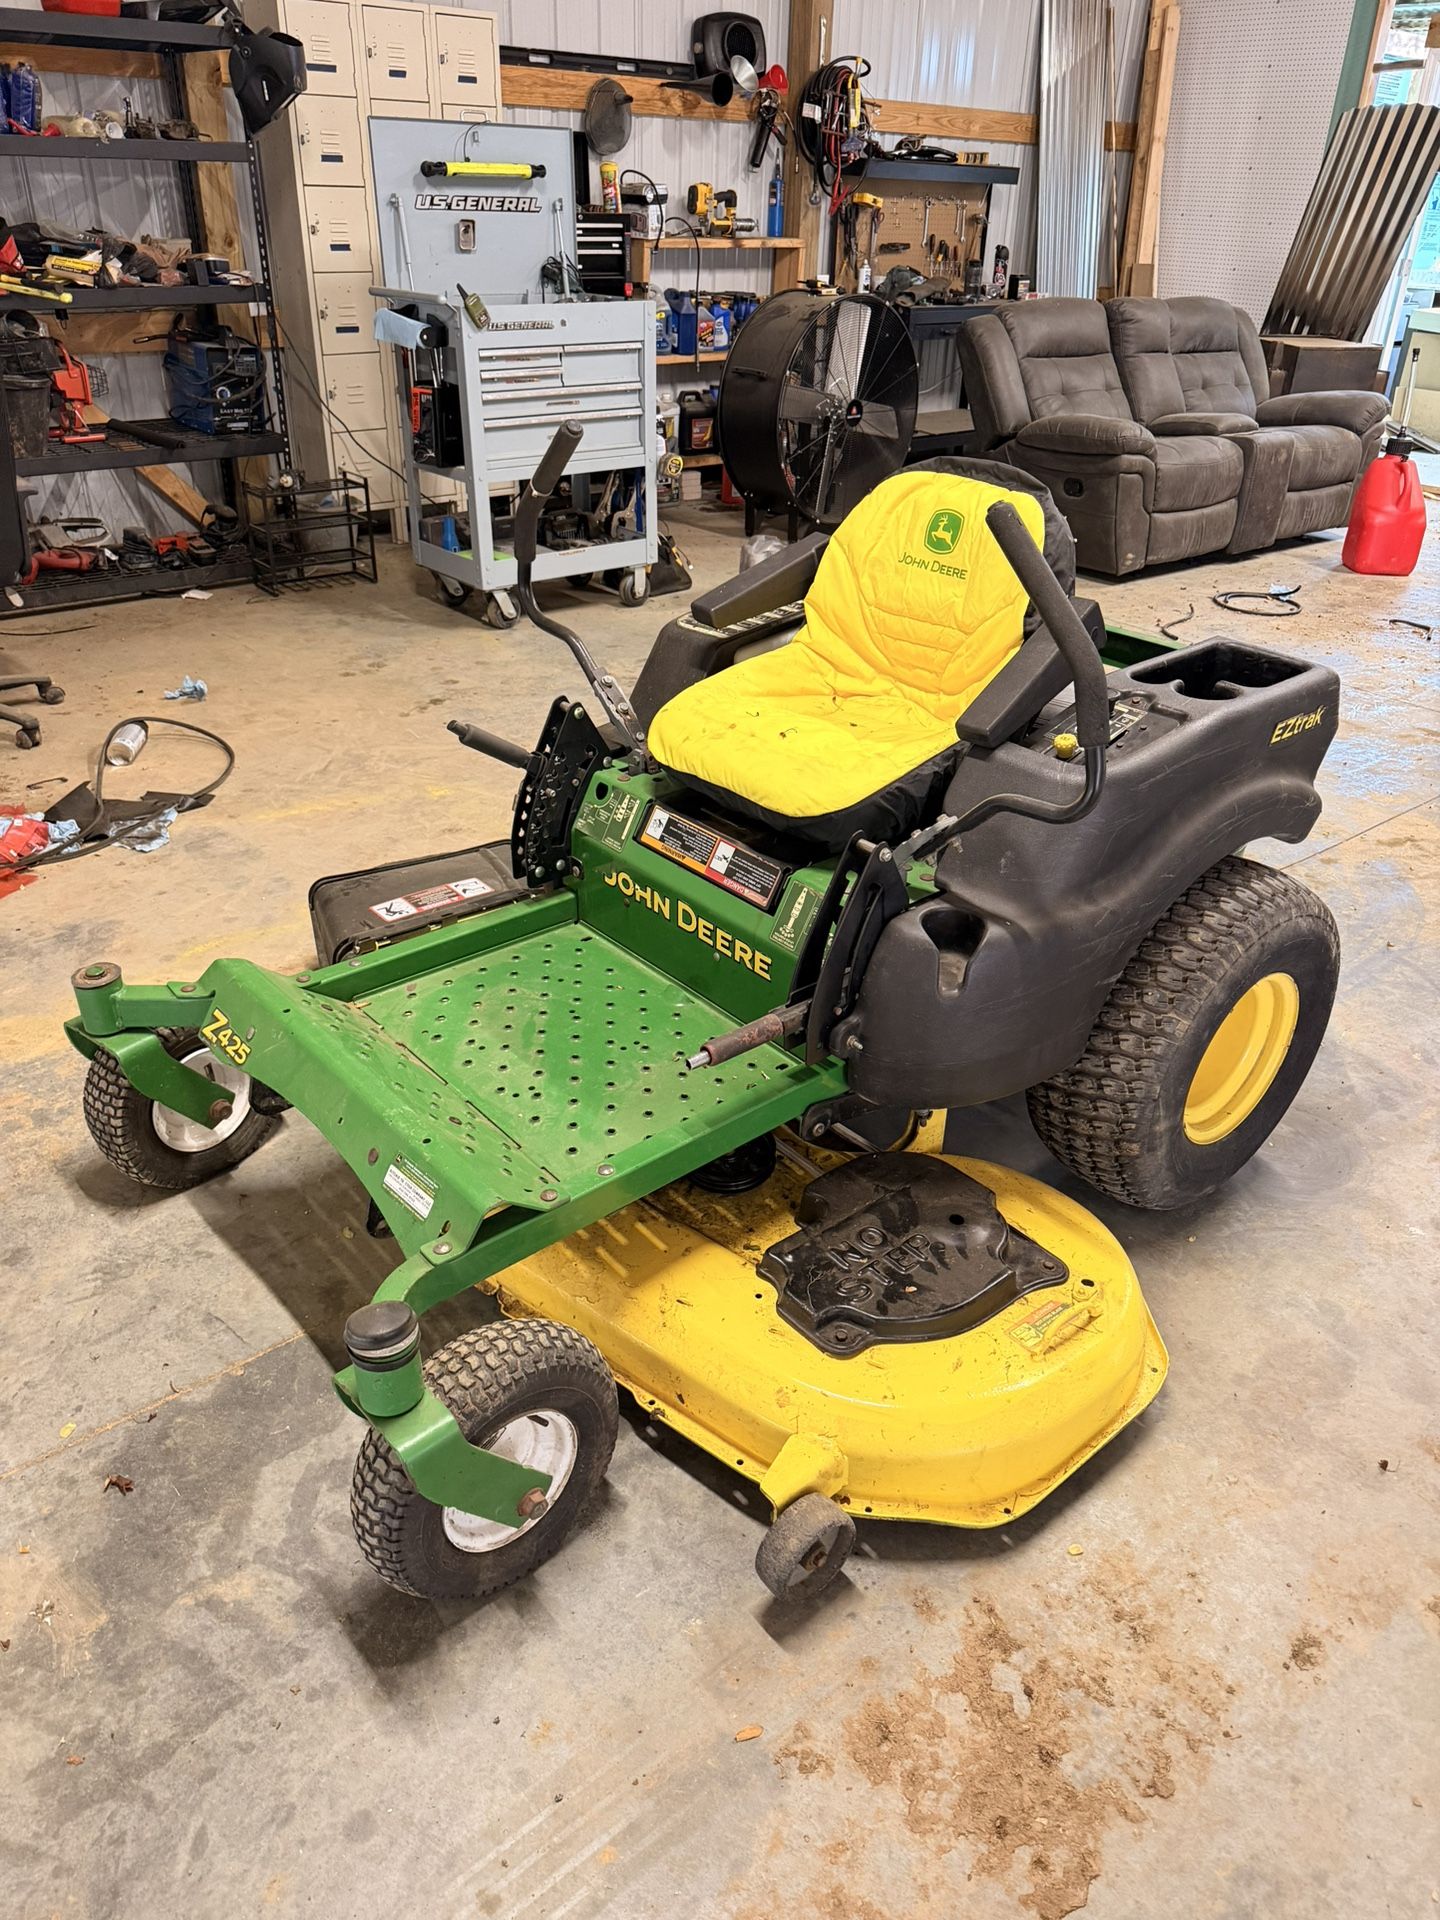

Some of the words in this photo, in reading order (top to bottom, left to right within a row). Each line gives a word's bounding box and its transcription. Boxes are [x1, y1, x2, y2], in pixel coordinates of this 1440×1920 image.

[449, 195, 542, 213] GENERAL
[506, 320, 554, 331] GENERAL
[897, 551, 930, 571] JOHN
[931, 560, 968, 580] DEERE
[1269, 705, 1326, 747] EZtrak
[603, 870, 671, 921] JOHN
[677, 900, 773, 981] DEERE
[200, 1008, 252, 1067] Z425
[830, 1226, 887, 1271] NO
[835, 1233, 932, 1303] STEP
